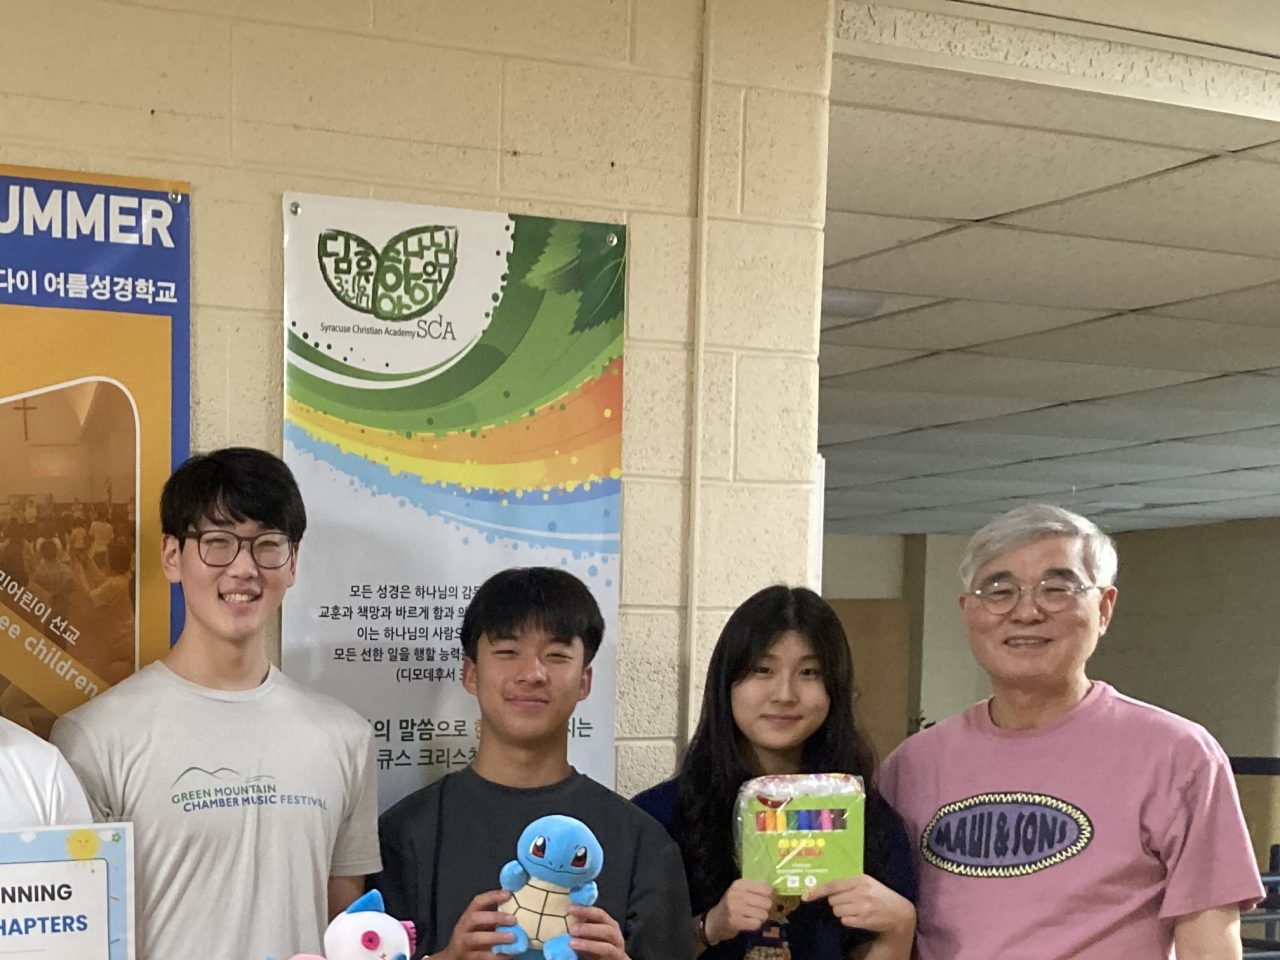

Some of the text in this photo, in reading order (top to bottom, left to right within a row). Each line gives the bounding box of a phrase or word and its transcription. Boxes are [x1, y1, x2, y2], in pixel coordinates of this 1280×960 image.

[45, 271, 178, 304] 여름성경학교
[320, 322, 416, 339] Syracuse Christian Academy
[350, 585, 372, 599] 모든
[377, 585, 411, 599] 성경은
[415, 586, 458, 599] 하나님의
[319, 606, 353, 620] 교훈과
[357, 606, 392, 620] 책망과
[396, 606, 429, 620] 바르게
[434, 606, 454, 620] 함과
[50, 616, 80, 645] 선교
[357, 627, 380, 641] 이는
[384, 627, 428, 641] 하나님의
[333, 648, 357, 661] 모든
[361, 648, 384, 661] 선한
[387, 648, 410, 661] 일을
[414, 648, 435, 661] 행할
[24, 636, 98, 697] children
[396, 668, 455, 682] (디모데후서
[373, 719, 391, 742] 의
[400, 718, 468, 742] 말씀으로
[171, 784, 276, 804] GREEN MOUNTAIN
[183, 794, 328, 812] CHAMBER MUSIC FESTIVAL
[934, 811, 1067, 858] MAUI & SONS
